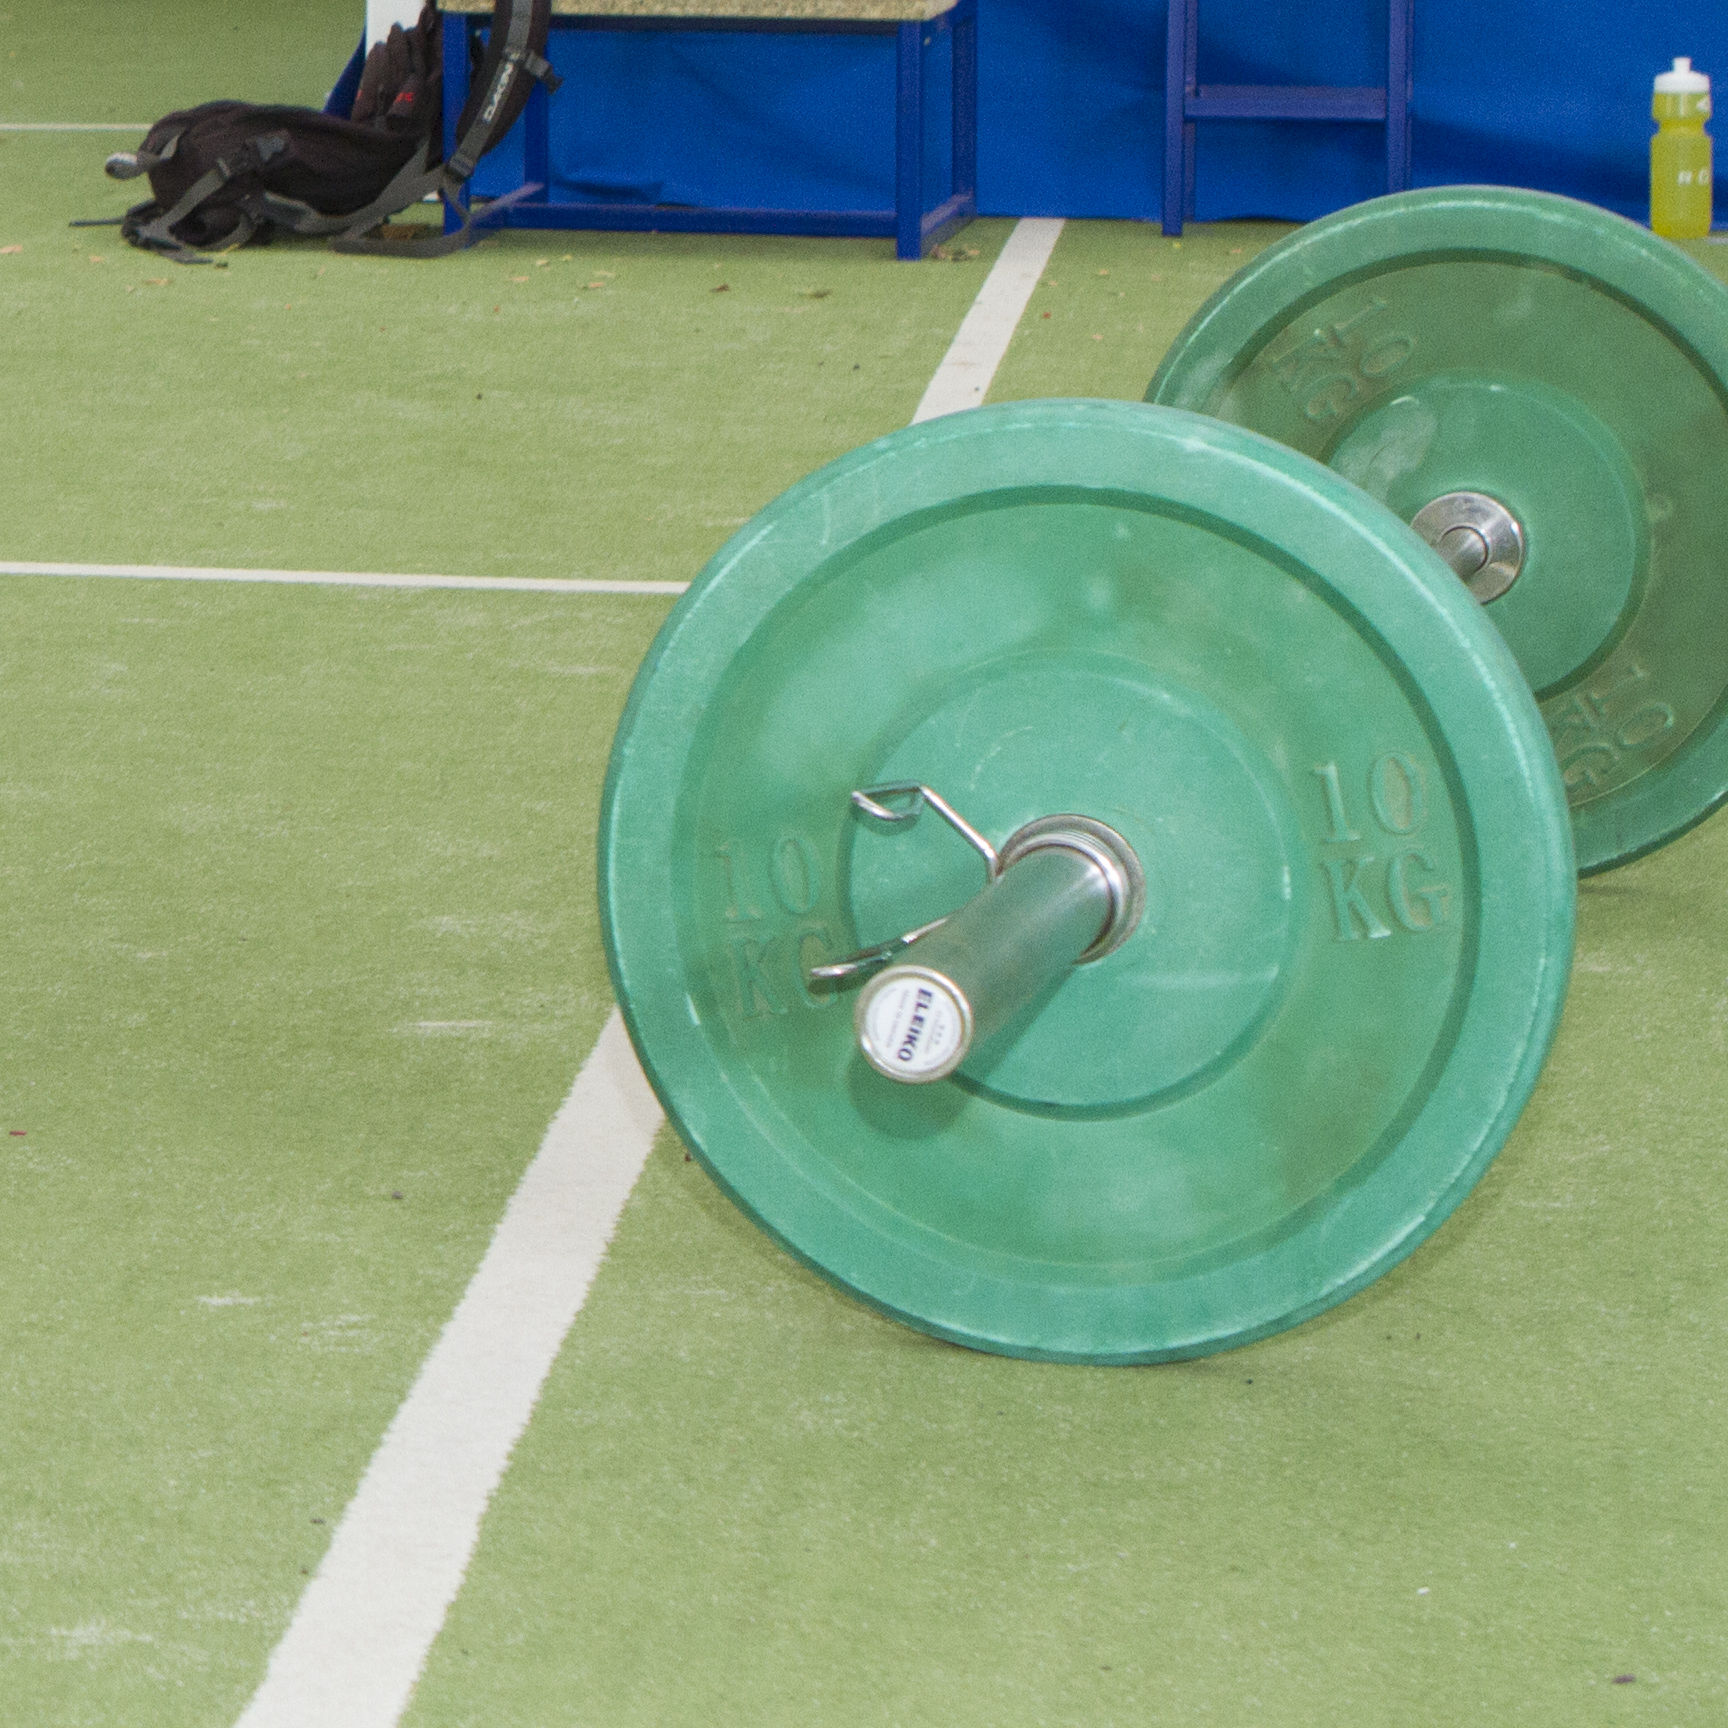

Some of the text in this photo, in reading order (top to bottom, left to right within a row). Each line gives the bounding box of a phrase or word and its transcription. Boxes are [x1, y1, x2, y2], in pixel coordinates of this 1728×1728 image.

[1310, 752, 1426, 843] 10
[711, 834, 825, 925] 10
[1318, 847, 1450, 943] KG
[897, 987, 933, 1061] ELEIKO
